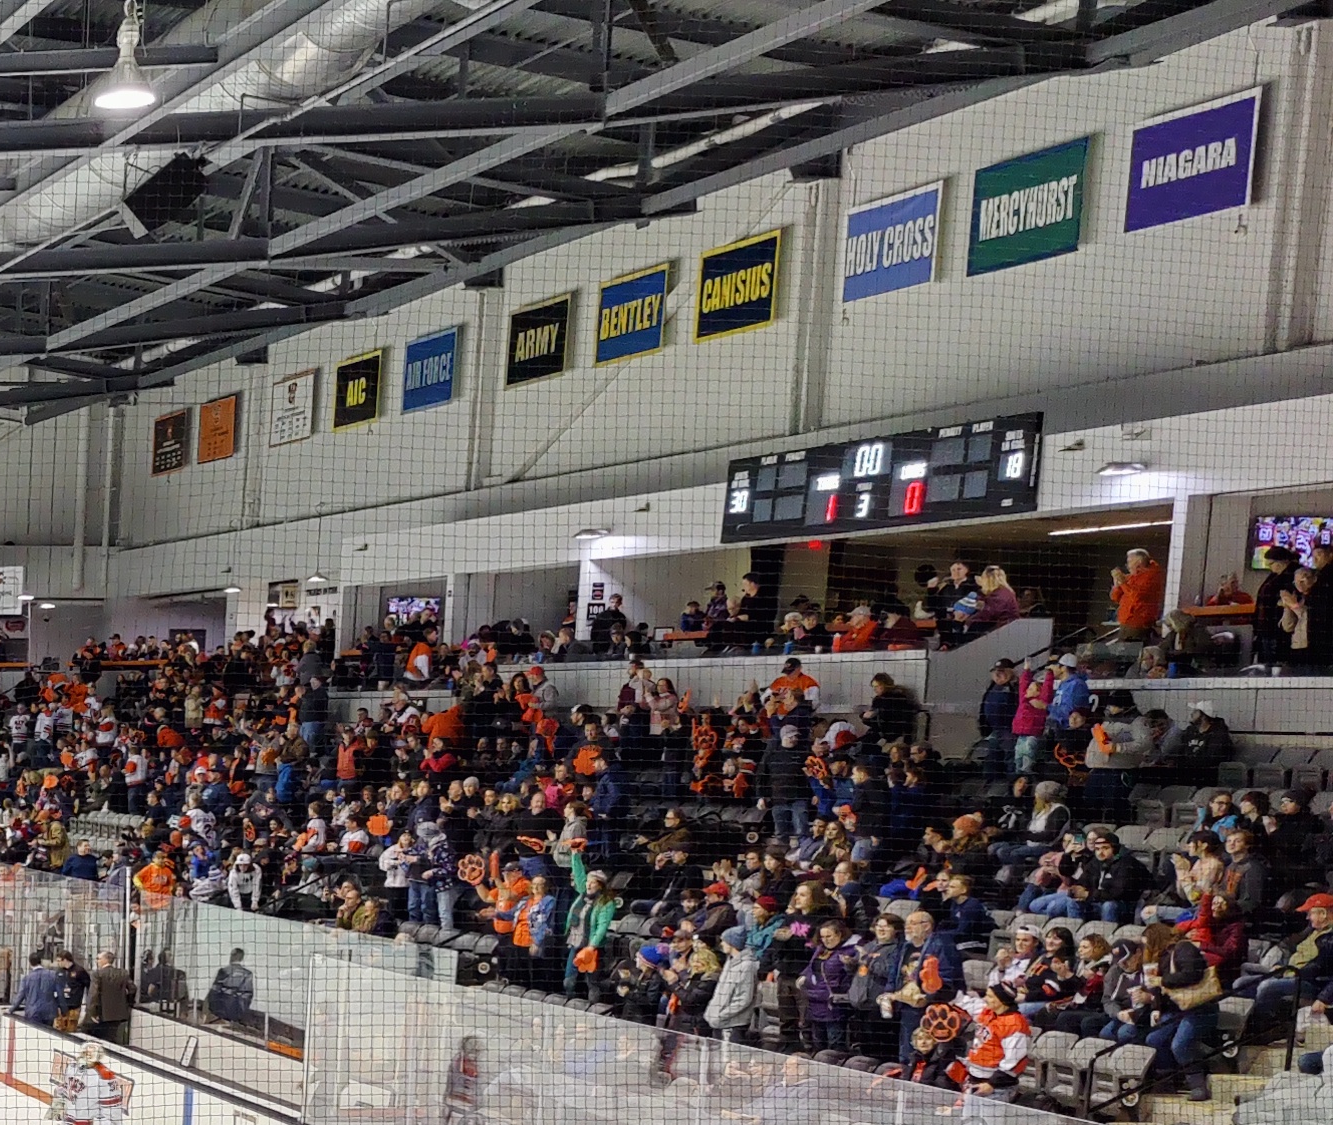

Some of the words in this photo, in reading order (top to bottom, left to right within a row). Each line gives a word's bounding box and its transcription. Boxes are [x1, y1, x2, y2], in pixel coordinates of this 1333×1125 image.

[1141, 137, 1237, 190] NIAGARA
[979, 175, 1078, 242] MERCYHURST
[844, 235, 879, 279] HOLY
[882, 217, 935, 266] CROSS
[702, 260, 772, 313] CANISIUS
[598, 293, 662, 342] BENTLEY
[514, 322, 559, 363] ARMY
[406, 363, 421, 390] AIR
[422, 352, 452, 385] FORCE
[346, 377, 366, 407] AIC
[729, 490, 749, 513] 30
[856, 493, 870, 518] 3
[904, 480, 924, 515] 0
